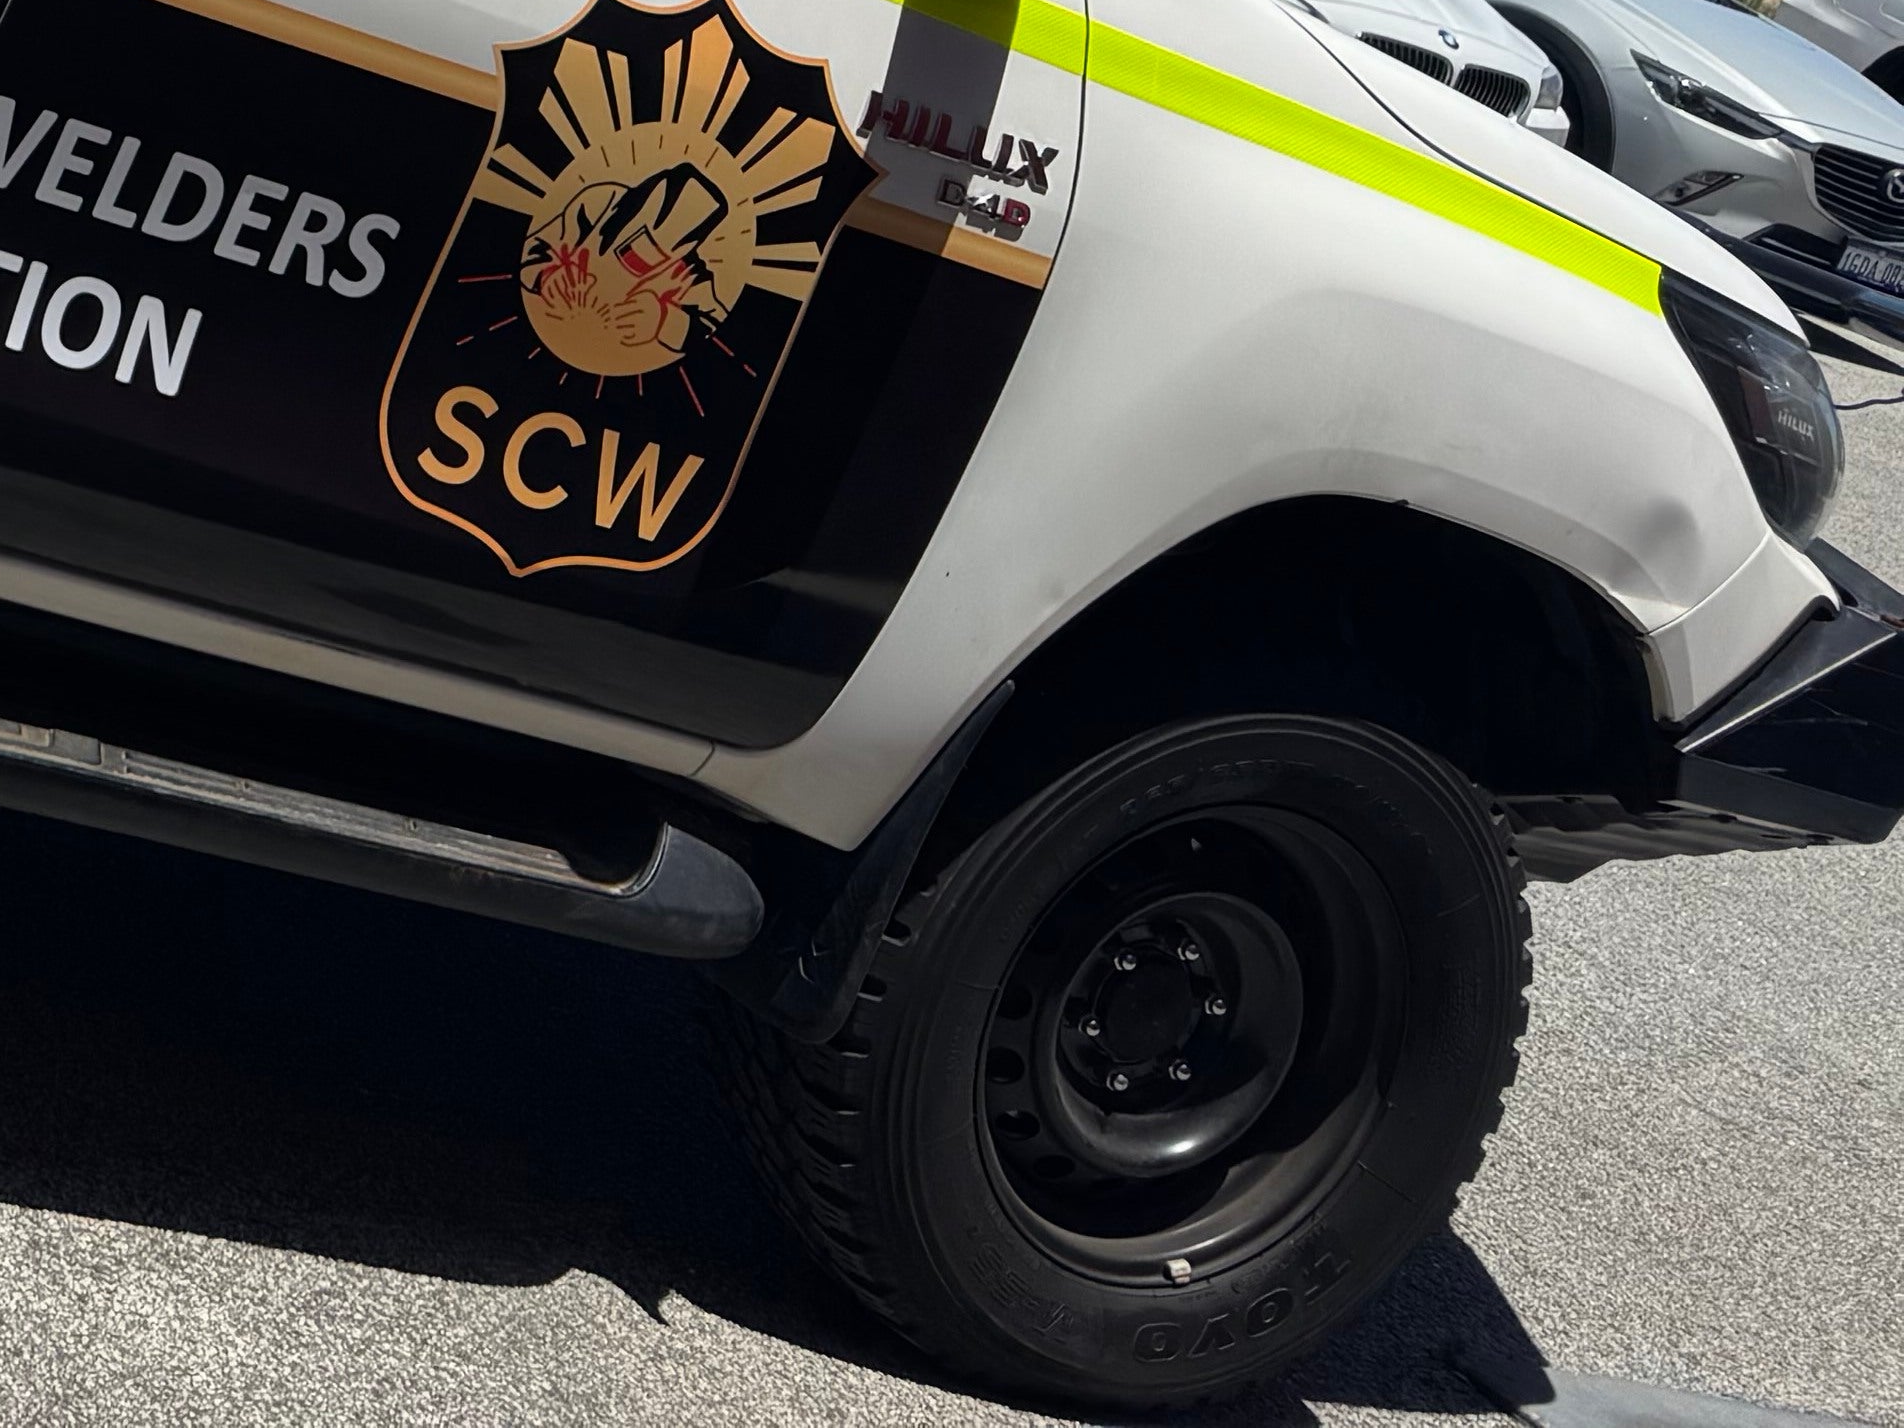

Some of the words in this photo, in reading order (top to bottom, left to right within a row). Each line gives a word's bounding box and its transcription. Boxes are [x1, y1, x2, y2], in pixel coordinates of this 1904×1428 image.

[855, 89, 1060, 197] HILUX
[416, 384, 704, 542] SCW
[1777, 409, 1815, 442] HILUX
[1133, 1251, 1352, 1363] TOYO
